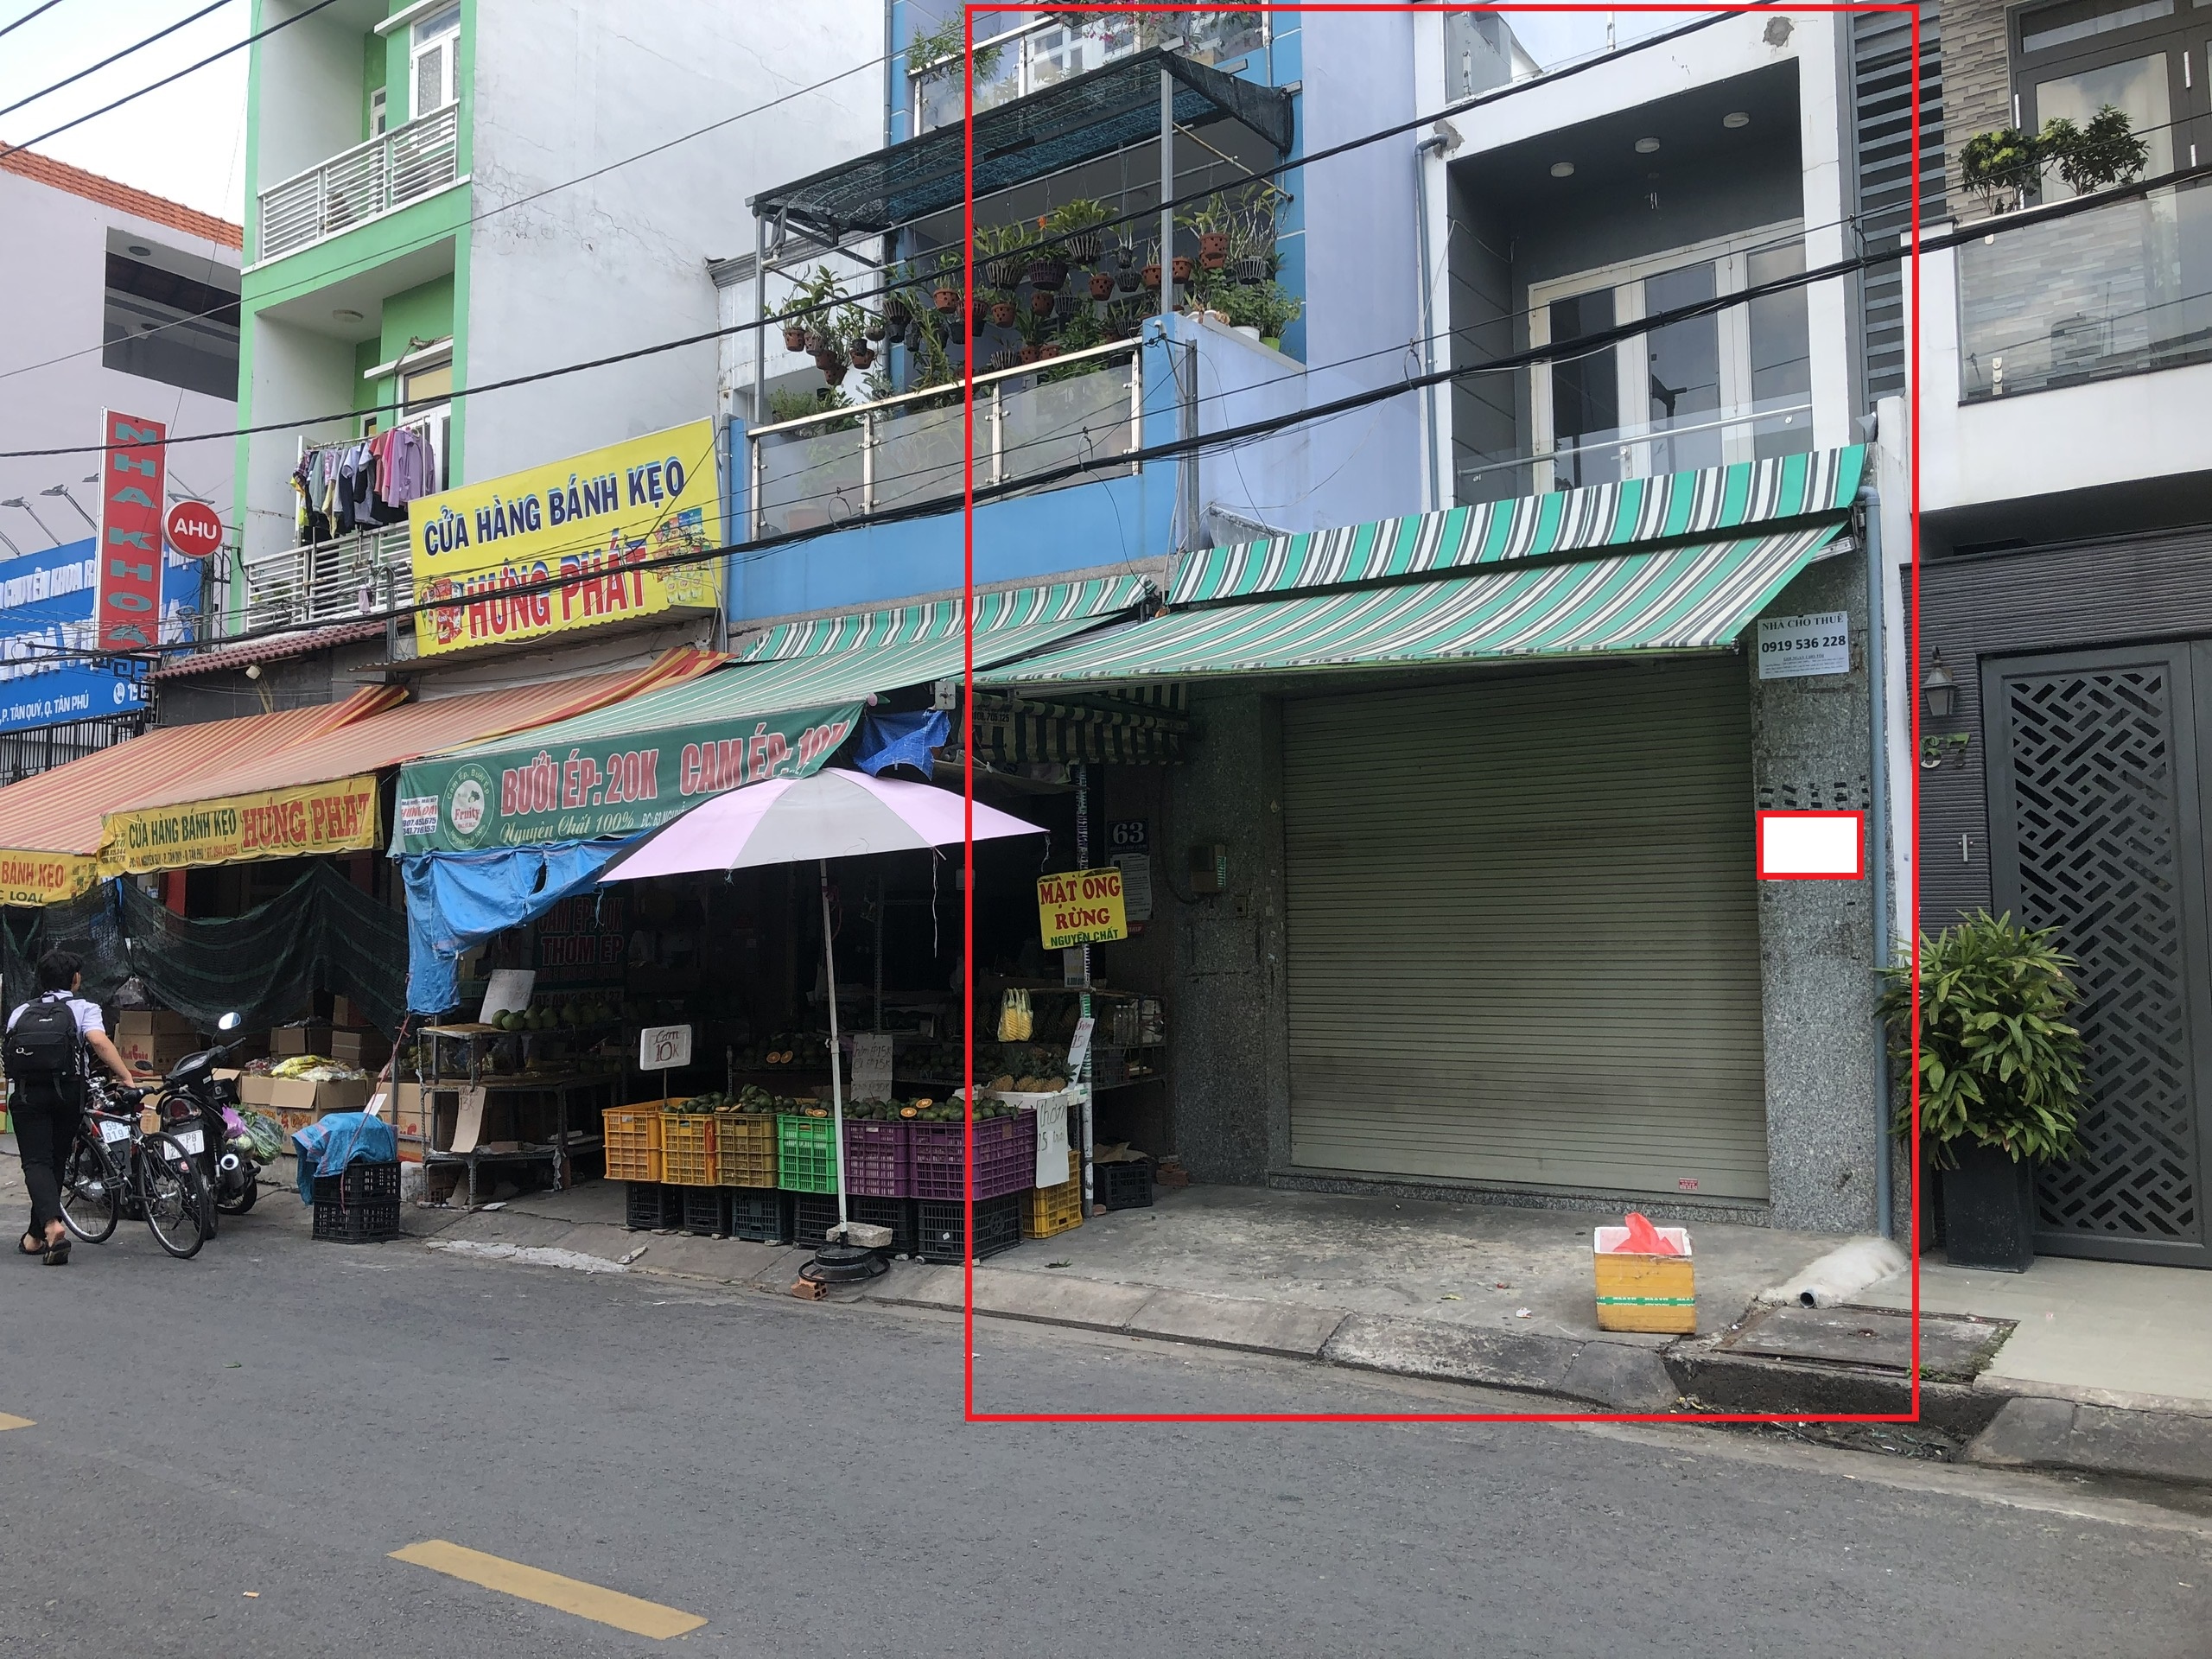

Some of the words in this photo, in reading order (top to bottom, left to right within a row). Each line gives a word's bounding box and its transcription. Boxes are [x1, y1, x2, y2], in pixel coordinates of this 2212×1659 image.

[423, 505, 469, 556] CỬA
[475, 494, 542, 544] HÀNG
[546, 473, 620, 526] BÁNH
[626, 455, 685, 510] KẸO
[174, 518, 217, 540] AHU
[465, 556, 553, 640] HƯNG
[559, 526, 648, 622] PHÁT
[1762, 619, 1784, 631] NHÀ
[1787, 618, 1811, 628] CHO
[1814, 613, 1844, 626] THUÊ
[1761, 640, 1793, 653] 0919
[1796, 638, 1819, 650] 536
[1822, 635, 1847, 647] 228
[10, 698, 25, 721] TÂN
[54, 695, 71, 715] TÂN
[71, 690, 89, 713] PHÚ
[500, 750, 559, 817] BƯỞI
[562, 748, 602, 810] ÉP:
[605, 748, 659, 804] 20K
[680, 737, 744, 797] CAM
[129, 813, 149, 849] CỬA
[150, 812, 179, 846] HÀNG
[181, 808, 211, 842] BÁNH
[213, 808, 237, 842] KẸO
[240, 796, 307, 852] HƯNG
[309, 781, 371, 845] PHÁT
[454, 806, 480, 821] Fruity
[499, 821, 554, 846] Nguyên
[557, 814, 592, 836] Chất
[594, 810, 635, 833] 100%
[1112, 822, 1145, 845] 63
[2, 855, 35, 887] BÁNH
[37, 863, 65, 893] KẸO
[1039, 874, 1077, 909] MẬT
[1082, 875, 1122, 900] ONG
[1054, 906, 1111, 931] RỪNG
[1093, 926, 1119, 941] CHẤT
[541, 932, 596, 967] THƠM
[655, 1040, 679, 1063] 10K
